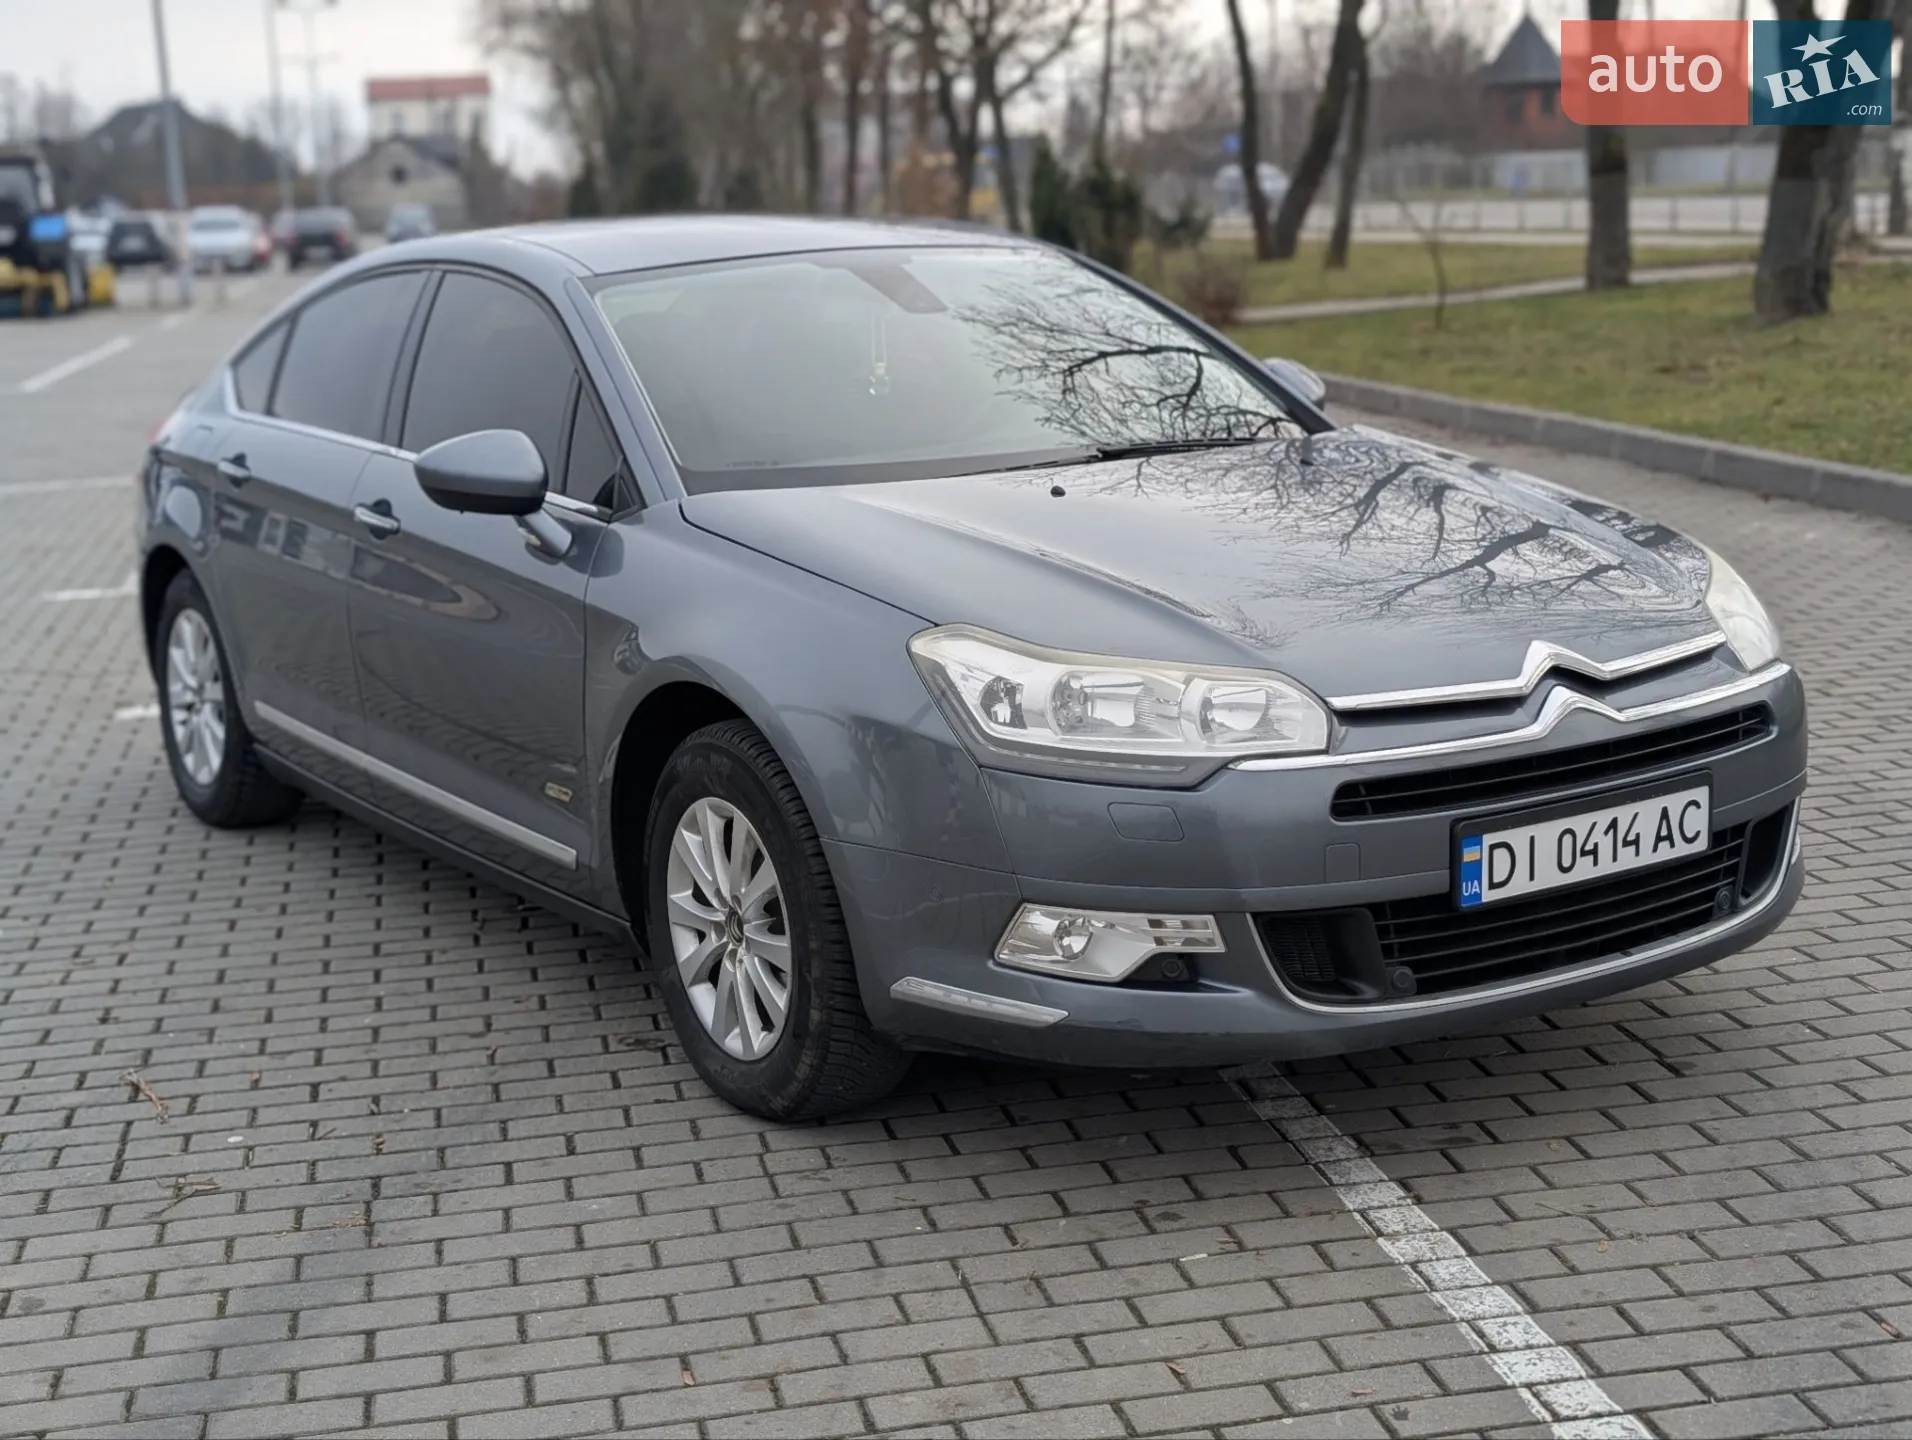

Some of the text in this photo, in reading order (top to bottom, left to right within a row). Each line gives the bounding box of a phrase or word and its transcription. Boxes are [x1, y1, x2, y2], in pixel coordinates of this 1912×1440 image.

[1487, 799, 1702, 891] DI 0414 AC
[1462, 879, 1481, 896] UA
